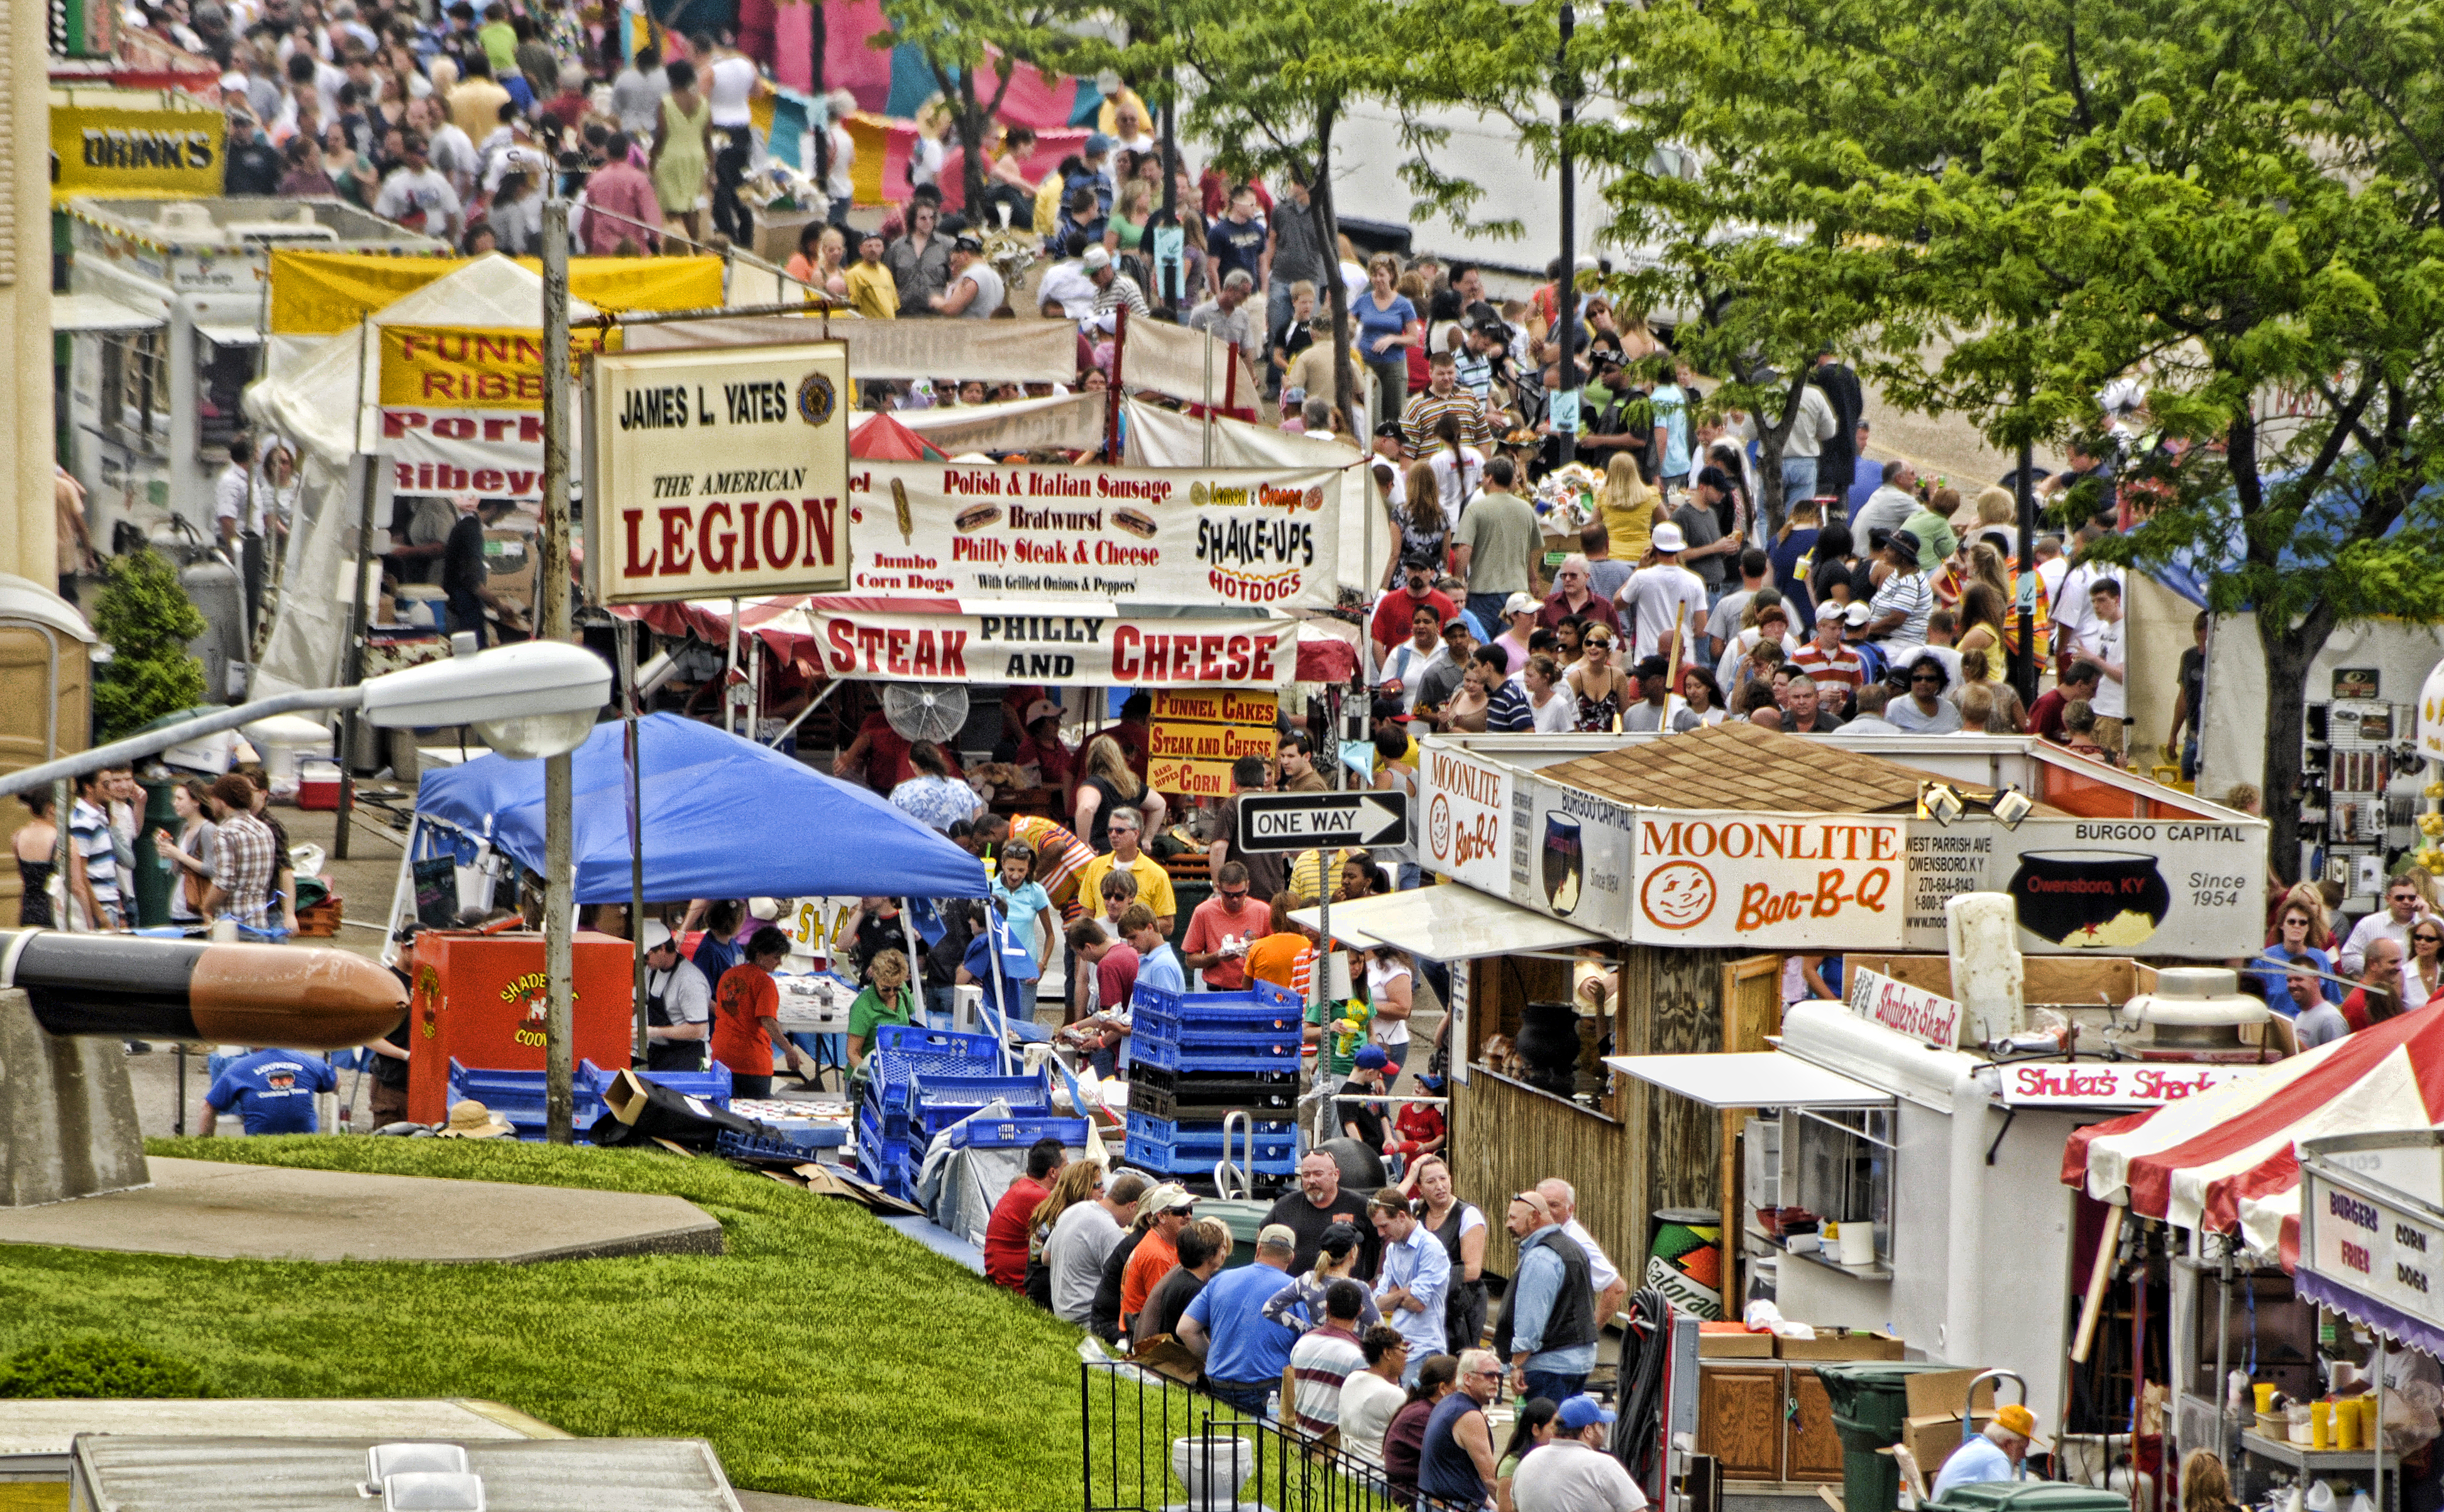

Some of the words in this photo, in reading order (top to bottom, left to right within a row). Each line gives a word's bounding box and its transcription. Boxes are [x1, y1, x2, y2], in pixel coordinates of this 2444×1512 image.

[619, 385, 688, 431] JAMES
[697, 385, 715, 426] L.
[724, 381, 788, 424] YATES
[395, 462, 545, 496] Ribey
[652, 474, 694, 498] THE
[698, 467, 808, 496] AMERICAN
[944, 469, 1001, 495] Polish
[1006, 470, 1023, 496] &
[1028, 471, 1092, 498] Italian
[1096, 472, 1172, 505] Sausage
[1258, 482, 1302, 515] Orange
[1008, 503, 1103, 532] Bratwurst
[622, 497, 838, 579] LEGION
[952, 536, 1010, 567] Philly
[1014, 537, 1068, 564] Steak
[1072, 539, 1089, 565] &
[1094, 539, 1160, 567] Cheese
[1196, 515, 1314, 569] SHAKE-UPS
[872, 552, 938, 570] Jumbo
[856, 572, 901, 589] Corn
[907, 574, 954, 593] Dogs
[1005, 574, 1040, 591] Grilled
[1043, 574, 1079, 591] Onions
[1081, 576, 1090, 592] &
[1208, 569, 1301, 603] HOTDOGS
[980, 616, 1104, 643] PHILLY
[827, 618, 967, 675] STEAK
[1005, 654, 1074, 679] AND
[1111, 624, 1278, 682] CHEESE
[1221, 692, 1275, 722] CAKES
[1179, 764, 1221, 793] CORN
[1430, 752, 1501, 809] MOONLITE
[1257, 812, 1302, 835] ONE
[1310, 809, 1357, 832] WAY
[2074, 824, 2157, 840] BURGOO
[2167, 825, 2245, 843] CAPITAL
[1640, 820, 1898, 861] MOONLITE
[1905, 836, 1930, 852] WEST
[1932, 836, 1971, 853] PARRISH
[1973, 836, 1993, 853] AVE
[1918, 877, 1974, 893] 270-684-8143
[2120, 877, 2146, 894] KY
[2188, 872, 2245, 889] Since
[1734, 865, 1890, 933] Bar-B-Q
[2192, 890, 2238, 907] 1954
[1875, 983, 1919, 1034] Shuler's
[1918, 997, 1956, 1047] Shack
[2015, 1067, 2118, 1097] Shuler's
[2329, 1190, 2379, 1234] BURGERS
[2395, 1222, 2426, 1253] CORN
[2340, 1239, 2370, 1274] FRIES
[2396, 1261, 2428, 1293] DOGS
